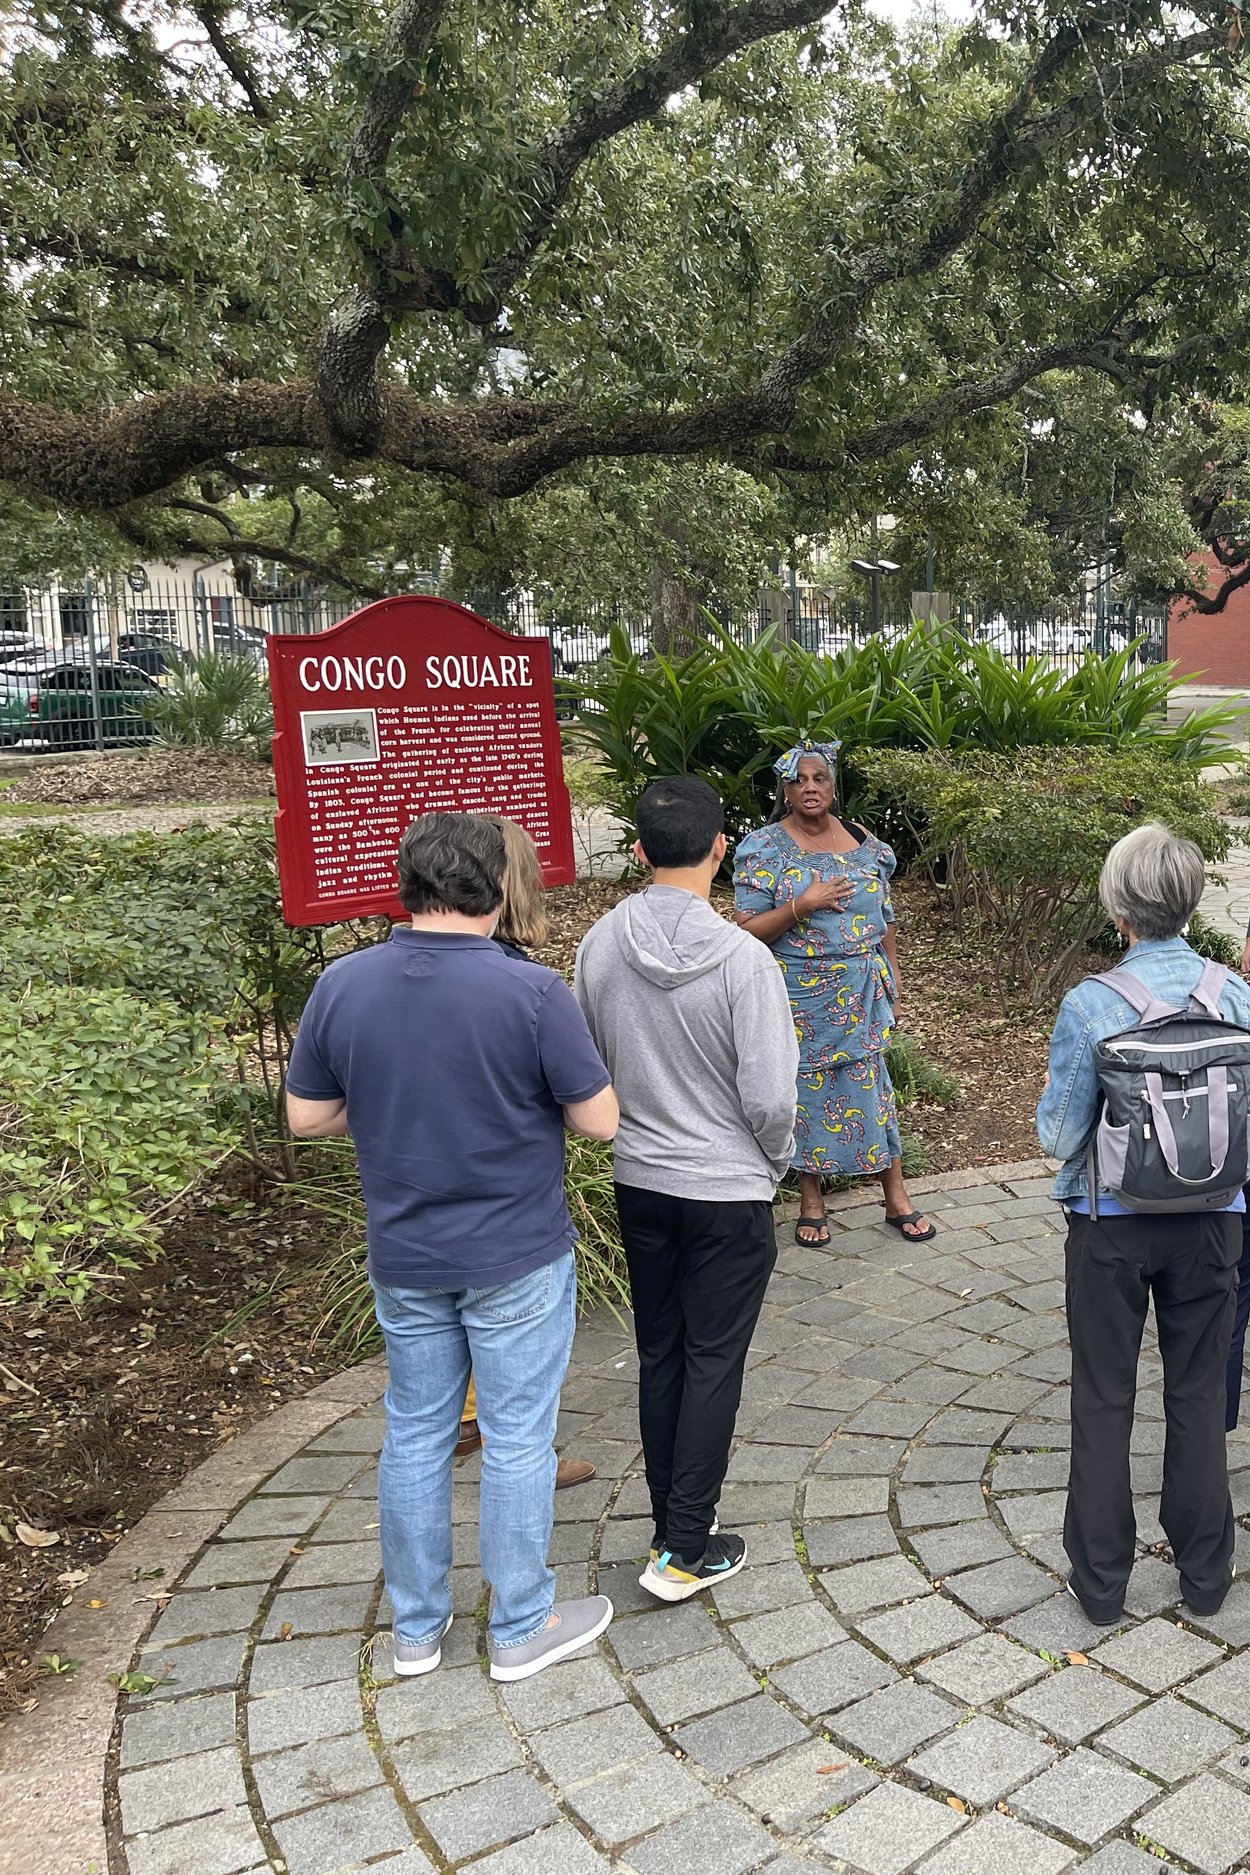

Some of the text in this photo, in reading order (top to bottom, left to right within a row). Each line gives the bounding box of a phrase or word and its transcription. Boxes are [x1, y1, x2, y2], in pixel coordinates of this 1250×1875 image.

[300, 656, 532, 691] CONGO SQUARE
[402, 749, 436, 758] gathering
[382, 760, 419, 769] originated
[306, 776, 350, 786] Louisiana's
[389, 771, 418, 779] colonial
[424, 769, 446, 777] period
[308, 789, 339, 798] Spanish
[346, 785, 377, 794] colonial
[513, 782, 546, 791] gatherings
[326, 809, 359, 818] enslaved
[315, 855, 348, 864] cultural
[355, 849, 399, 860] expressions
[318, 880, 336, 888] jazz
[364, 872, 392, 880] rhythm
